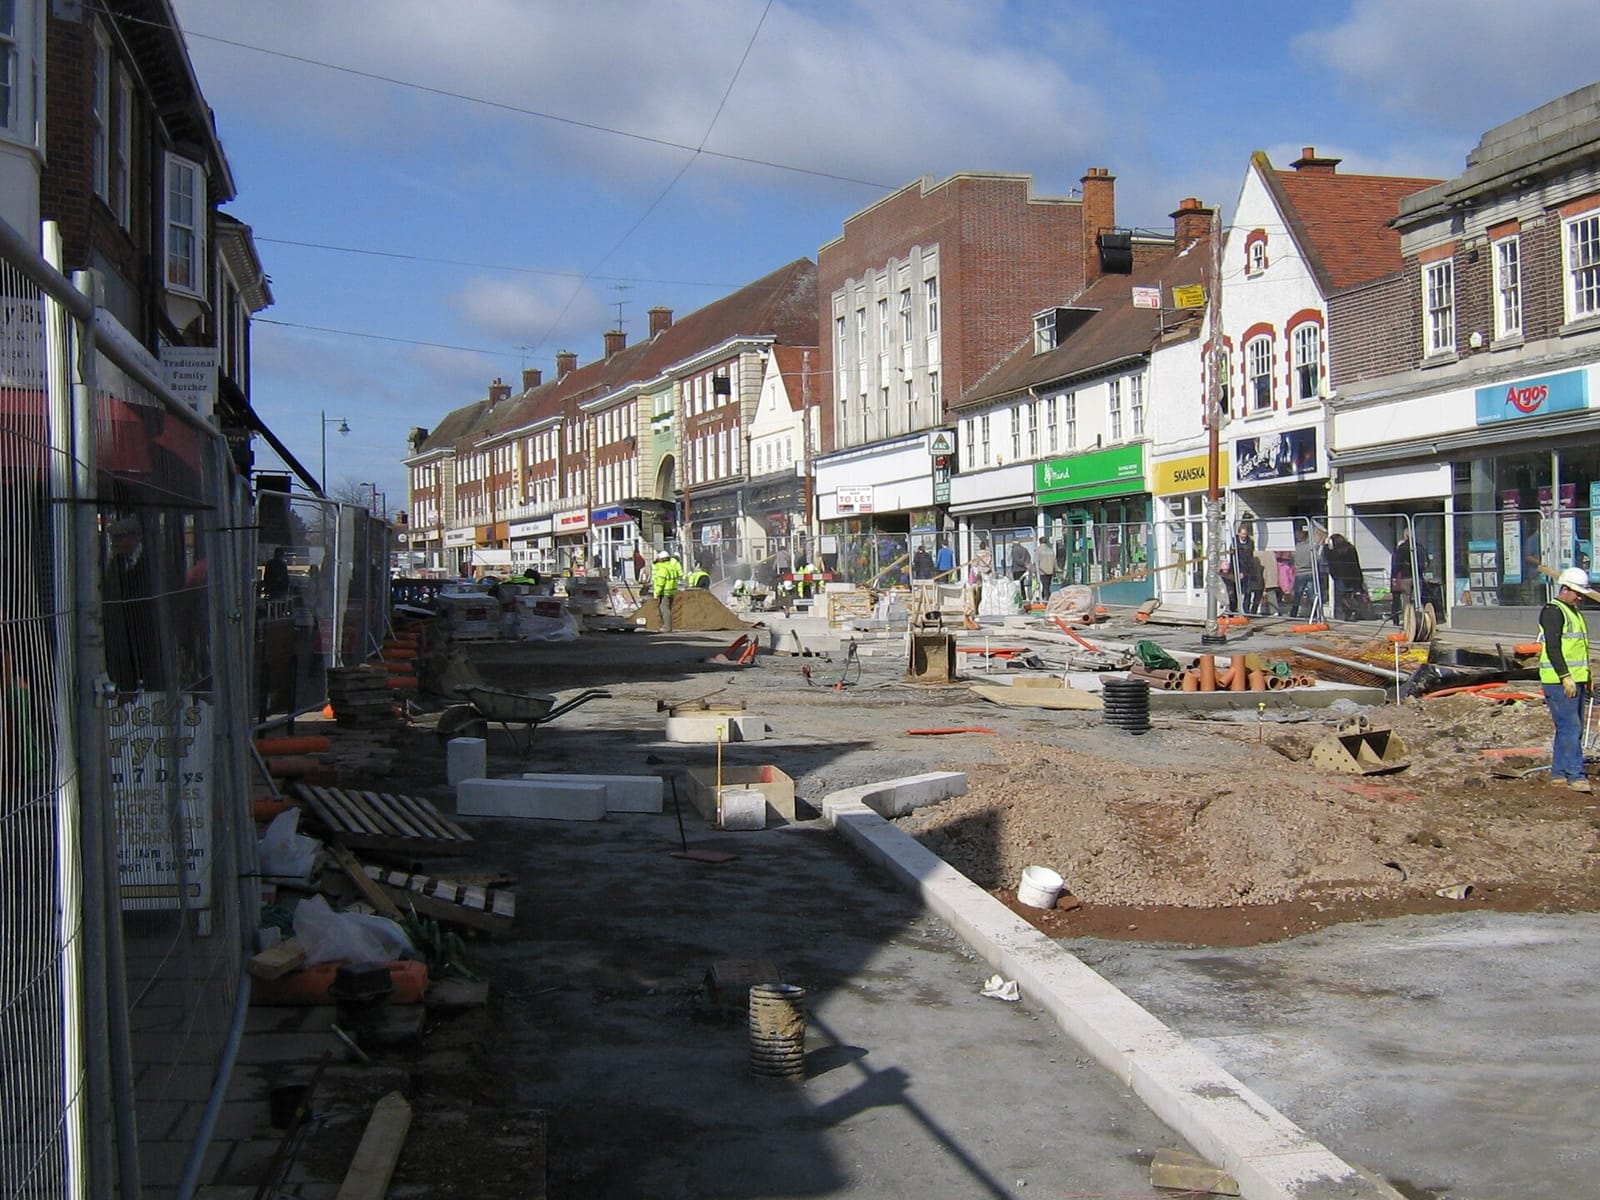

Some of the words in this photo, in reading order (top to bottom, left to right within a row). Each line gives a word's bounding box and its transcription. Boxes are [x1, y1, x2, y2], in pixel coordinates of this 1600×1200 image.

[164, 359, 216, 368] Traditional
[173, 371, 205, 382] Family
[170, 382, 208, 392] Butcher
[1505, 384, 1548, 408] Argos
[1173, 466, 1206, 482] SKANSKA
[839, 496, 851, 504] TO
[854, 495, 872, 503] LET
[155, 768, 204, 786] Dys
